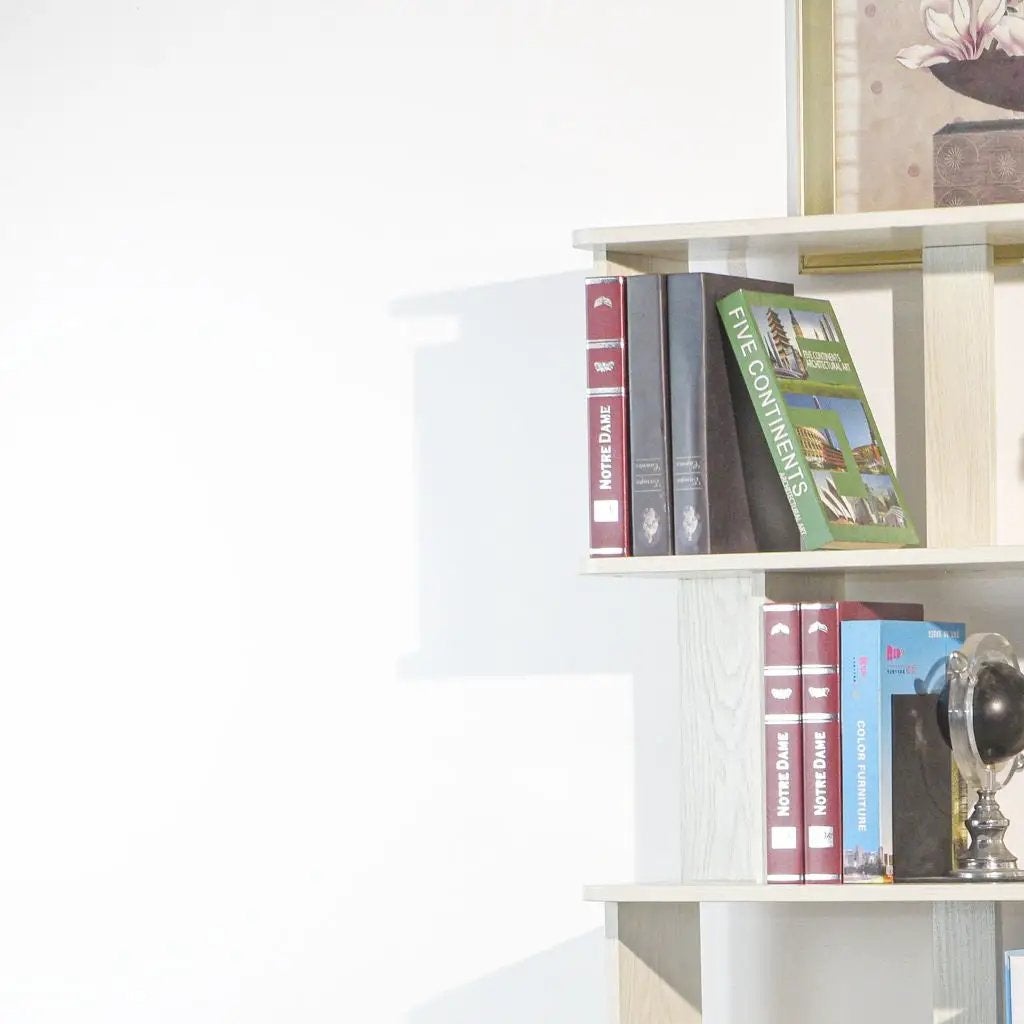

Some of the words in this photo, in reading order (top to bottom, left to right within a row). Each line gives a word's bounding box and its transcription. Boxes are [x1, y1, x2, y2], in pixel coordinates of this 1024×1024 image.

[728, 306, 758, 357] FIVE
[748, 360, 808, 497] CONTINENTS
[598, 405, 612, 444] DAME
[599, 444, 612, 490] NOTRE
[775, 732, 790, 770] DAME
[813, 731, 827, 769] DAME
[856, 719, 866, 761] COLOR
[777, 771, 790, 817] NOTRE
[813, 771, 827, 816] NOTRE
[857, 764, 867, 833] FURNITURE
